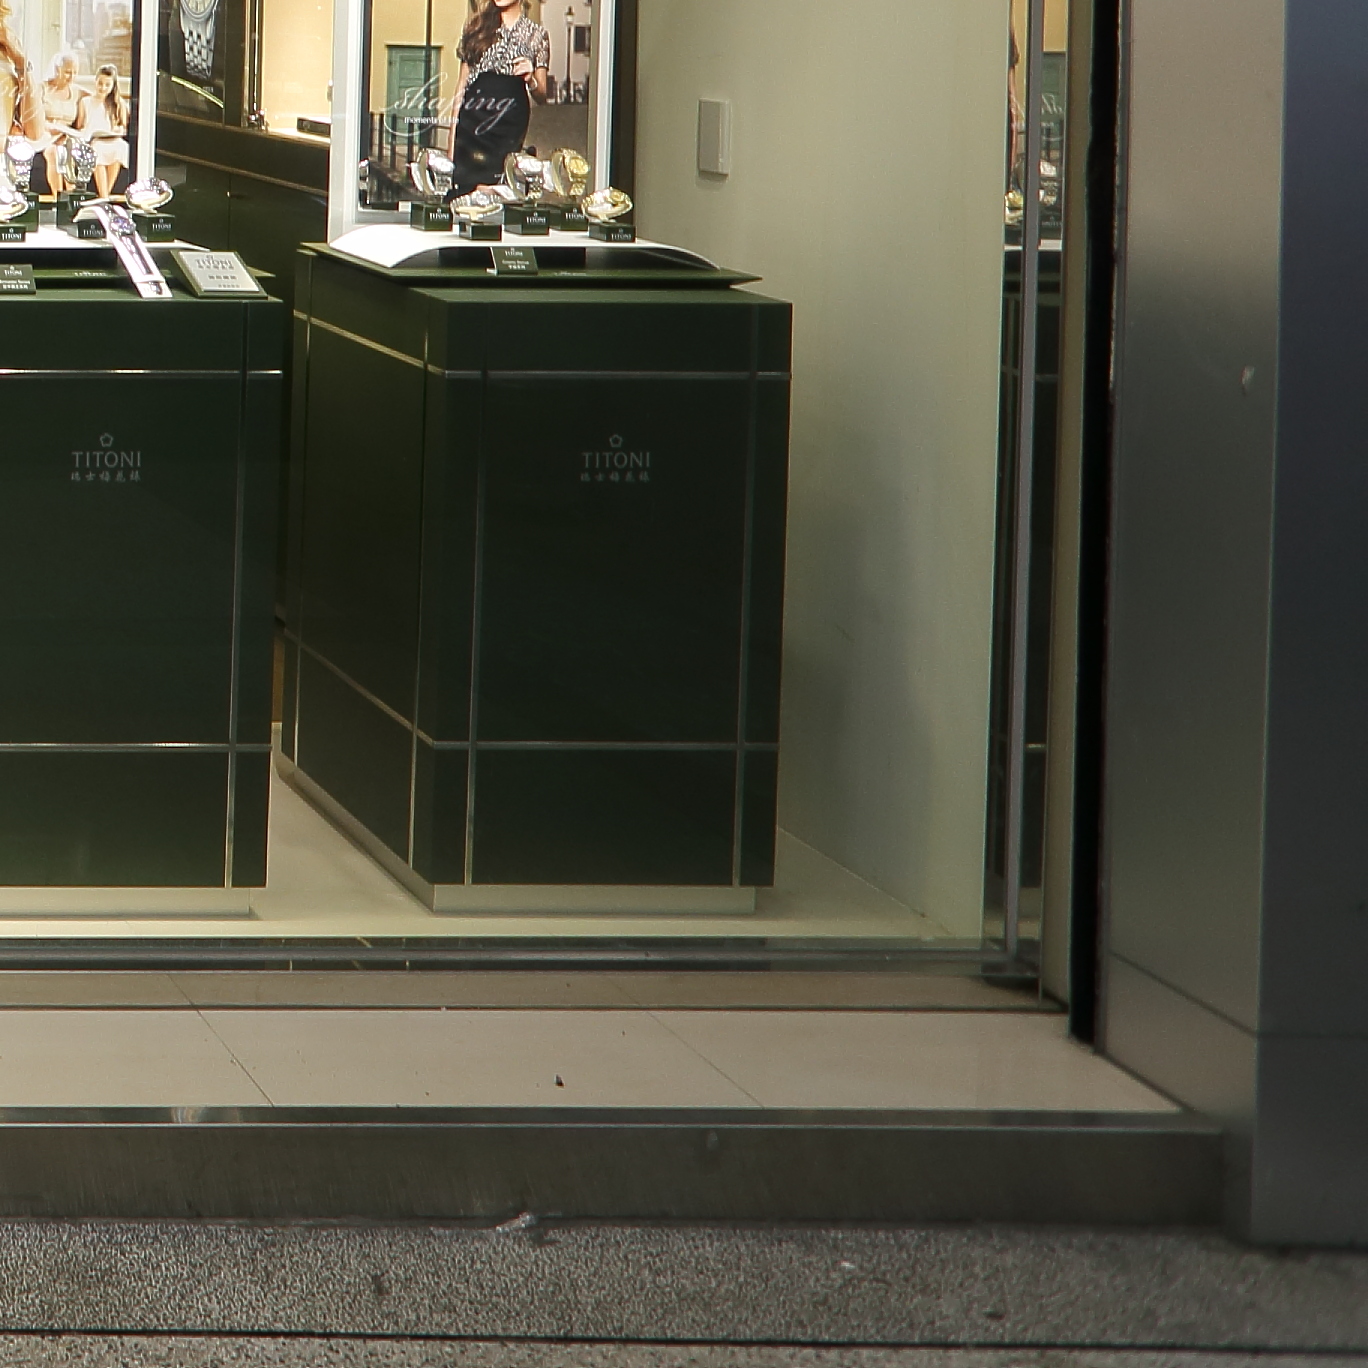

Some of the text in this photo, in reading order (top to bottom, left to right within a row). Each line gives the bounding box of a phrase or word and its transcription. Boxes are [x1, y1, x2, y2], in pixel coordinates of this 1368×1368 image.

[379, 72, 516, 136] shaping
[71, 451, 141, 468] TITONI
[582, 451, 651, 468] TITONI
